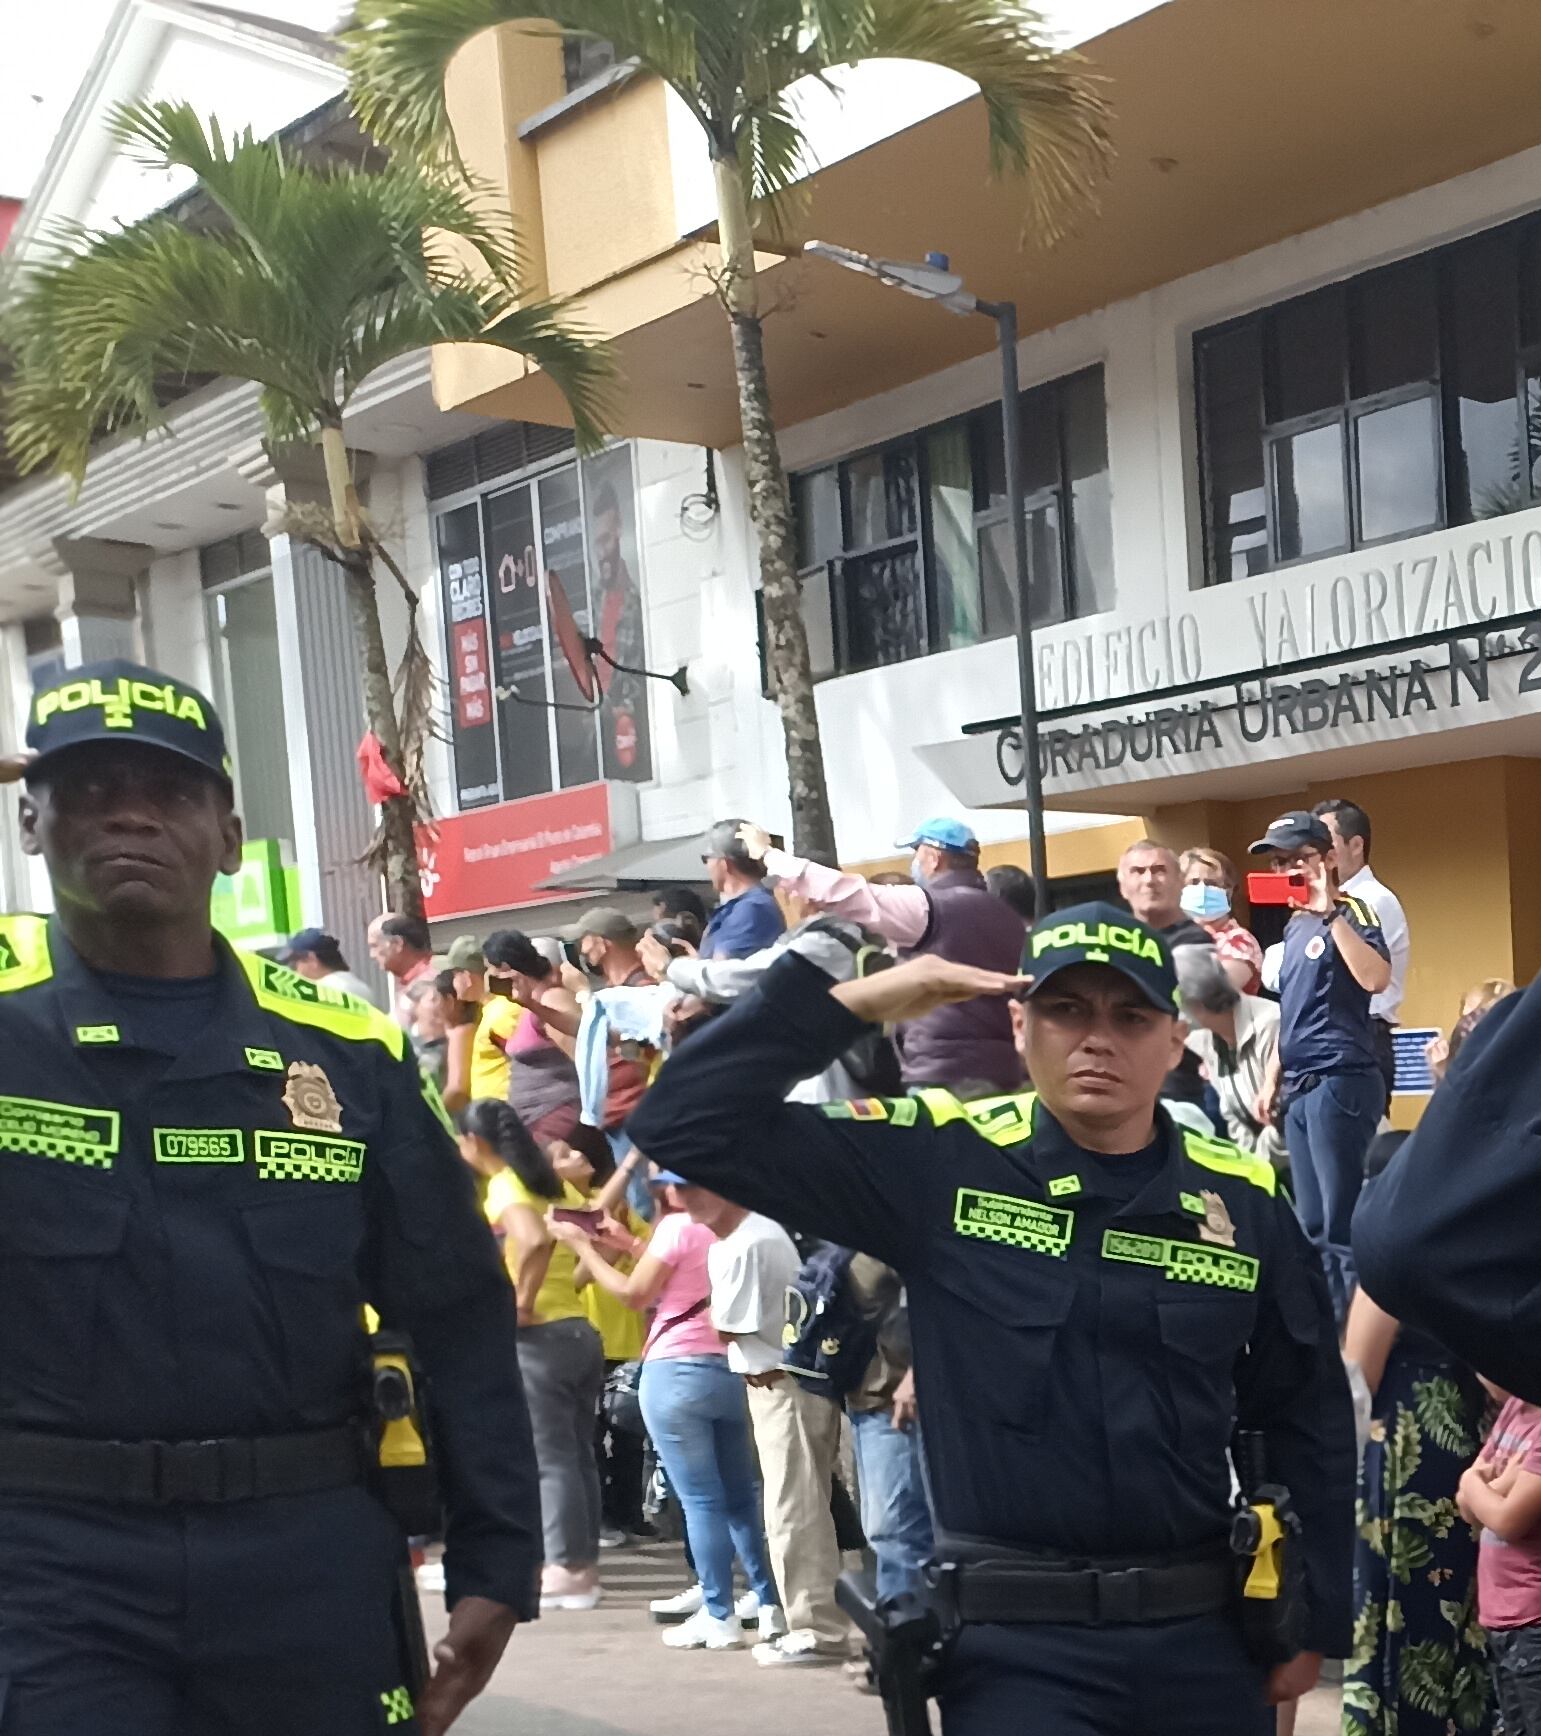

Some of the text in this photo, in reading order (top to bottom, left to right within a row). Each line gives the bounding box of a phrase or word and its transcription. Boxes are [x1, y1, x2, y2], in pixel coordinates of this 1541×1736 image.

[1037, 612, 1202, 709] EDIFICIO
[36, 678, 207, 731] POLICÍA
[1234, 660, 1437, 742] URBANA
[1032, 922, 1163, 967] POLICÍA
[165, 1135, 231, 1156] 079565
[270, 1140, 358, 1166] POLICÍA
